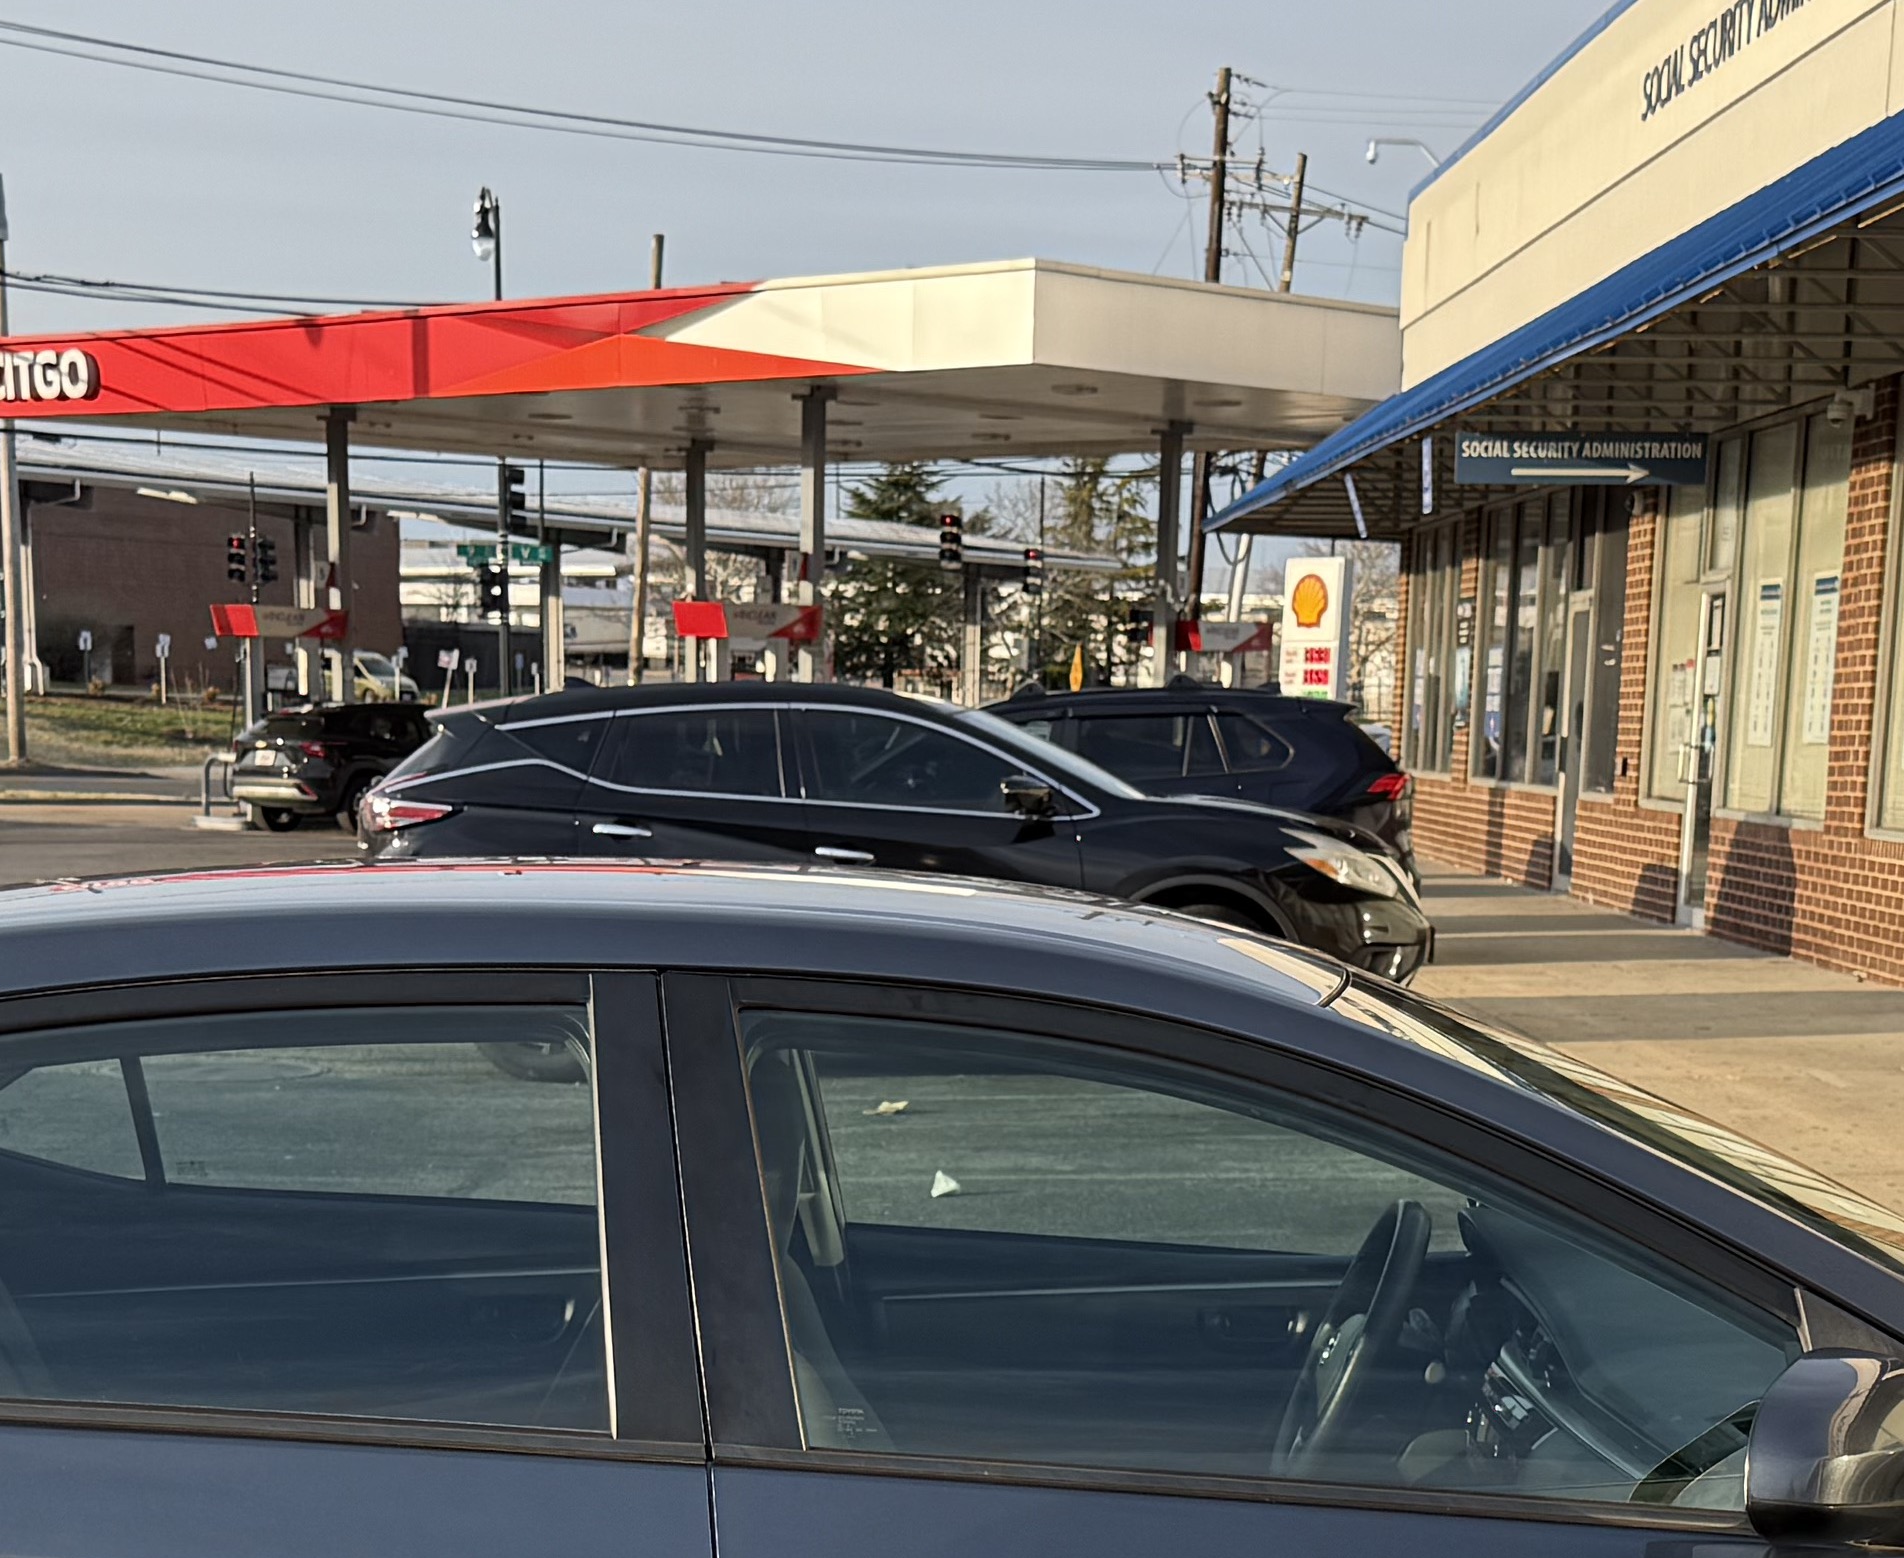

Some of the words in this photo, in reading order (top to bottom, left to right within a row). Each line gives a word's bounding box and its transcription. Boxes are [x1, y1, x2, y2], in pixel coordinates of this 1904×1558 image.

[1641, 45, 1685, 121] SOCIAL
[1688, 0, 1753, 87] SECURITY
[1462, 440, 1510, 458] SOCIAL
[1513, 440, 1580, 459] SECURITY
[1582, 441, 1702, 458] ADMINISTRATION
